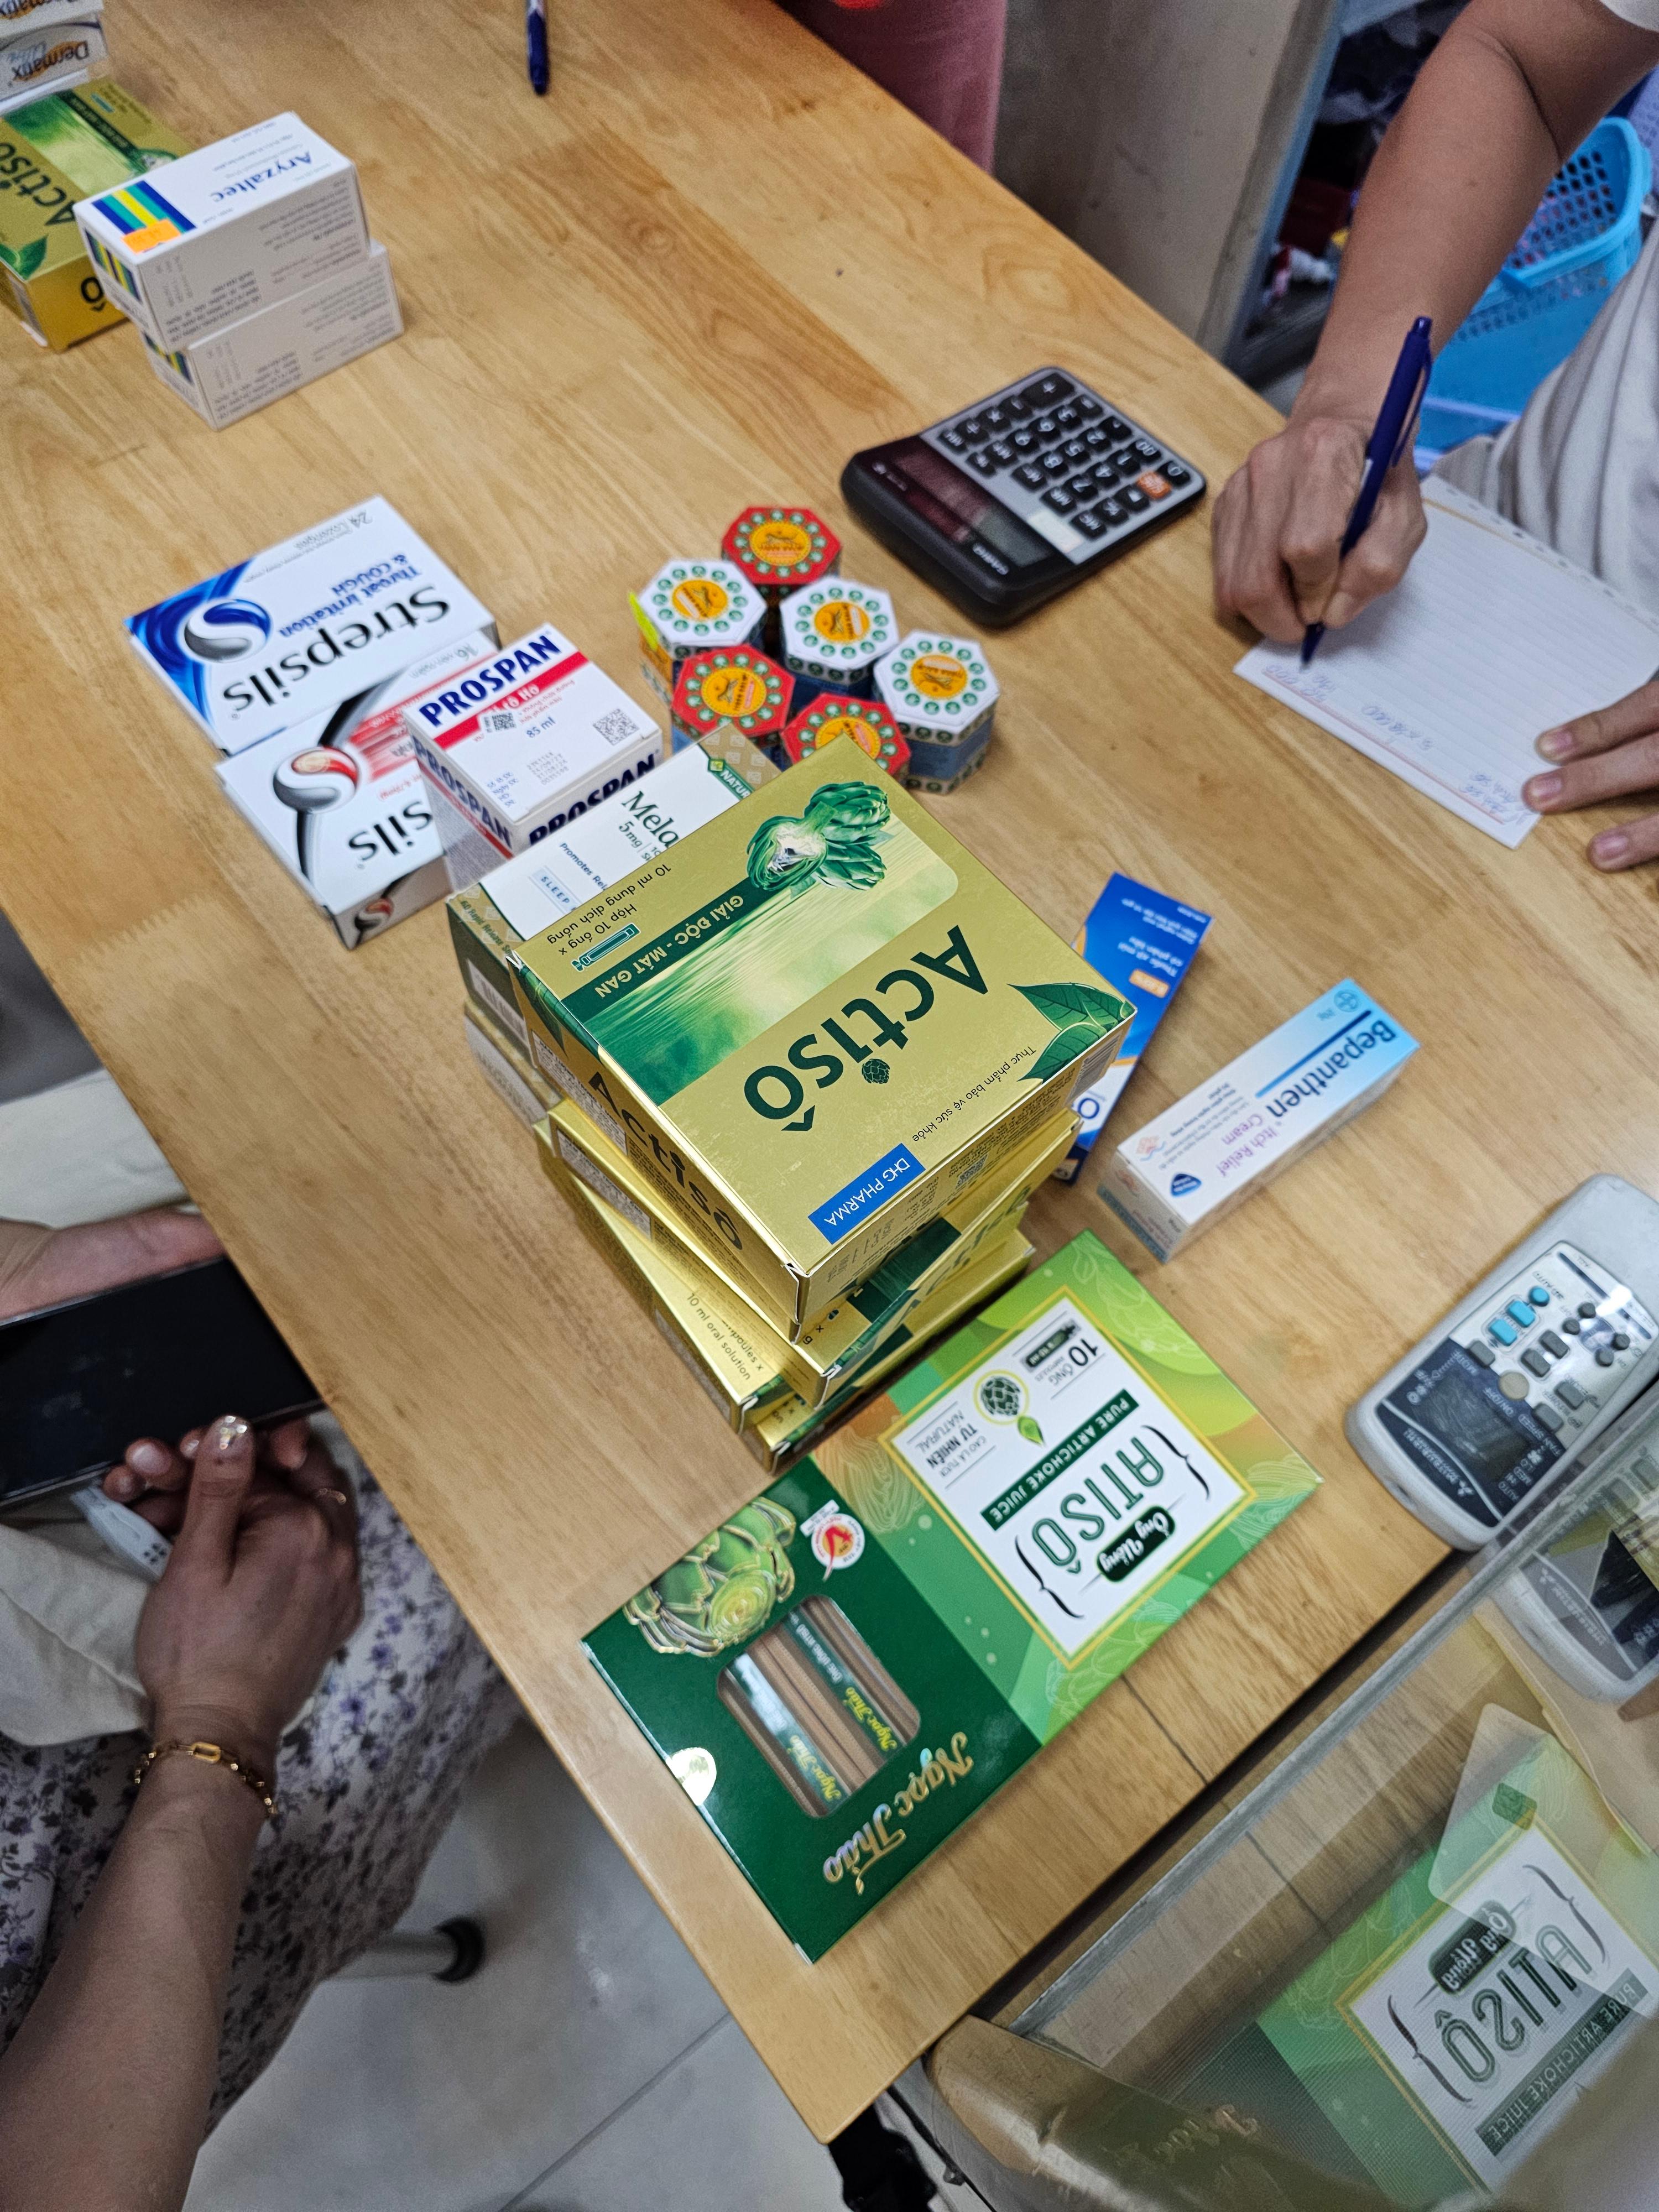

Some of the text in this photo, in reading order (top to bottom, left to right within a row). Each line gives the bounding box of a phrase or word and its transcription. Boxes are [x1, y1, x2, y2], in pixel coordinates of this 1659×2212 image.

[209, 152, 312, 202] Aryzaltec
[332, 562, 391, 595] COUGH
[363, 566, 421, 598] Throat
[223, 586, 450, 712] Strepsils
[419, 632, 559, 728] PROSPAN
[526, 716, 556, 738] 85 ml
[414, 735, 512, 849] PROSPAN
[560, 842, 593, 877] Promotes
[541, 875, 570, 905] SLEEP
[546, 864, 672, 945] 10 ml dung dịch uống
[709, 895, 744, 922] GIẢI
[559, 904, 637, 956] Hộp 10 ống x
[674, 916, 712, 945] ĐỘC
[634, 946, 668, 975] MÁT
[594, 971, 633, 998] GAN
[744, 925, 988, 1131] Actisô
[1265, 1020, 1396, 1118] Bepanthen
[912, 1045, 1036, 1143] Thực phẩm bảo vệ sức khỏe
[1221, 1113, 1264, 1147] Cream
[883, 1158, 910, 1182] DHG
[1217, 1143, 1255, 1177] Relief
[824, 1181, 884, 1226] PHARMA
[687, 1292, 751, 1380] 10 ml oral solution
[1068, 1338, 1098, 1366] 10
[915, 1410, 965, 1453] NATURAL
[926, 1423, 978, 1469] TỰ NHIÊN
[992, 1397, 1131, 1522] PURE ARTICHOKE JUICE
[1032, 1438, 1164, 1574] ATISÔ
[823, 1731, 975, 1895] Ngọc Thảo
